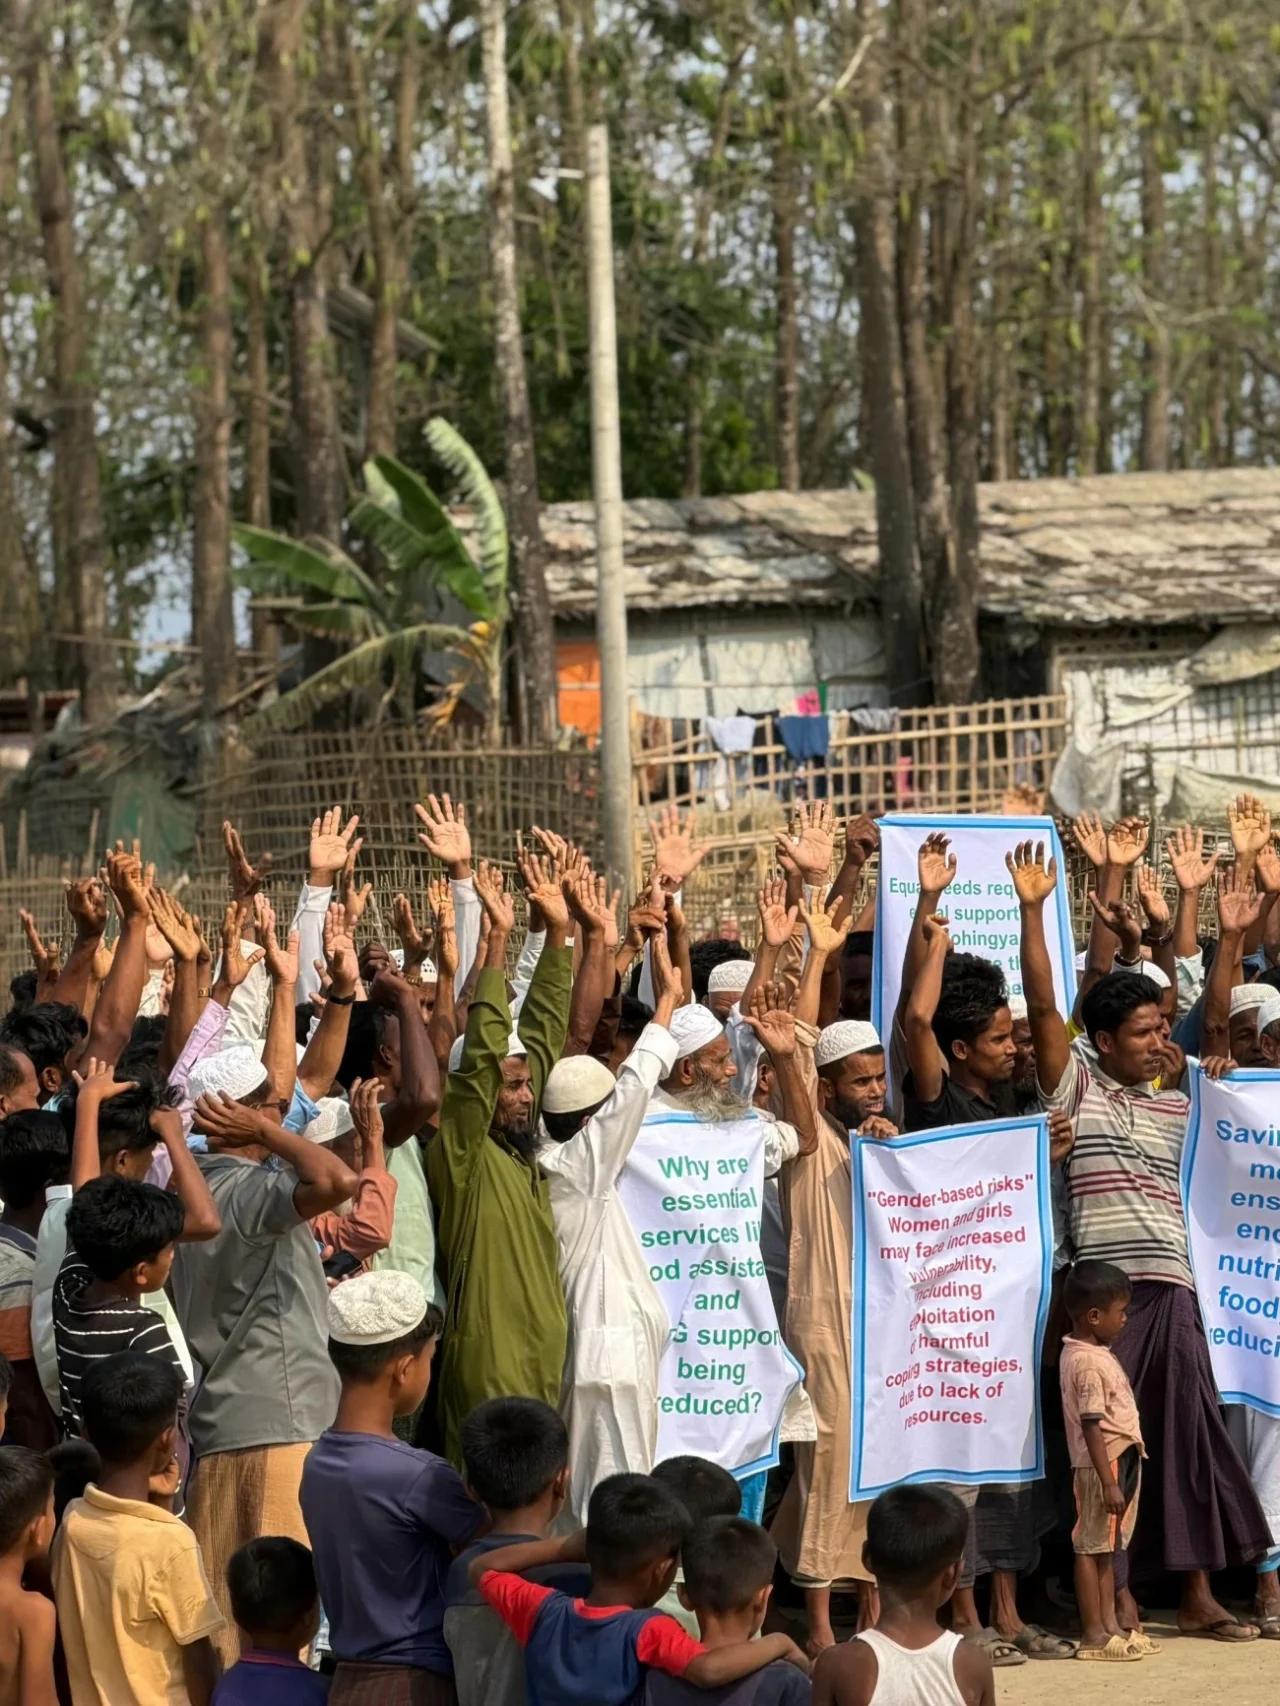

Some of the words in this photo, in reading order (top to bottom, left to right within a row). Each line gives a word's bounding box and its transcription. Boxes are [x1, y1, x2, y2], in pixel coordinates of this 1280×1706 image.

[944, 880, 981, 896] eeds
[954, 905, 1019, 925] support
[950, 930, 1019, 949] ohingya
[658, 1155, 710, 1181] Why
[717, 1156, 749, 1175] are
[662, 1187, 757, 1212] essential
[867, 1181, 984, 1208] "Gender-based
[888, 1216, 949, 1234] Women
[953, 1207, 977, 1228] and
[976, 1201, 1012, 1223] girls
[641, 1223, 739, 1248] services
[880, 1246, 910, 1263] may
[916, 1241, 945, 1259] face
[947, 1226, 1026, 1250] increased
[689, 1257, 765, 1279] assista
[694, 1290, 740, 1311] and
[914, 1281, 982, 1303] including
[697, 1328, 781, 1350] suppor
[919, 1331, 989, 1350] harmful
[677, 1357, 746, 1386] being
[925, 1355, 1023, 1379] strategies,
[917, 1384, 933, 1399] to
[940, 1382, 980, 1400] lack
[985, 1381, 1004, 1399] of
[904, 1409, 987, 1431] resources.
